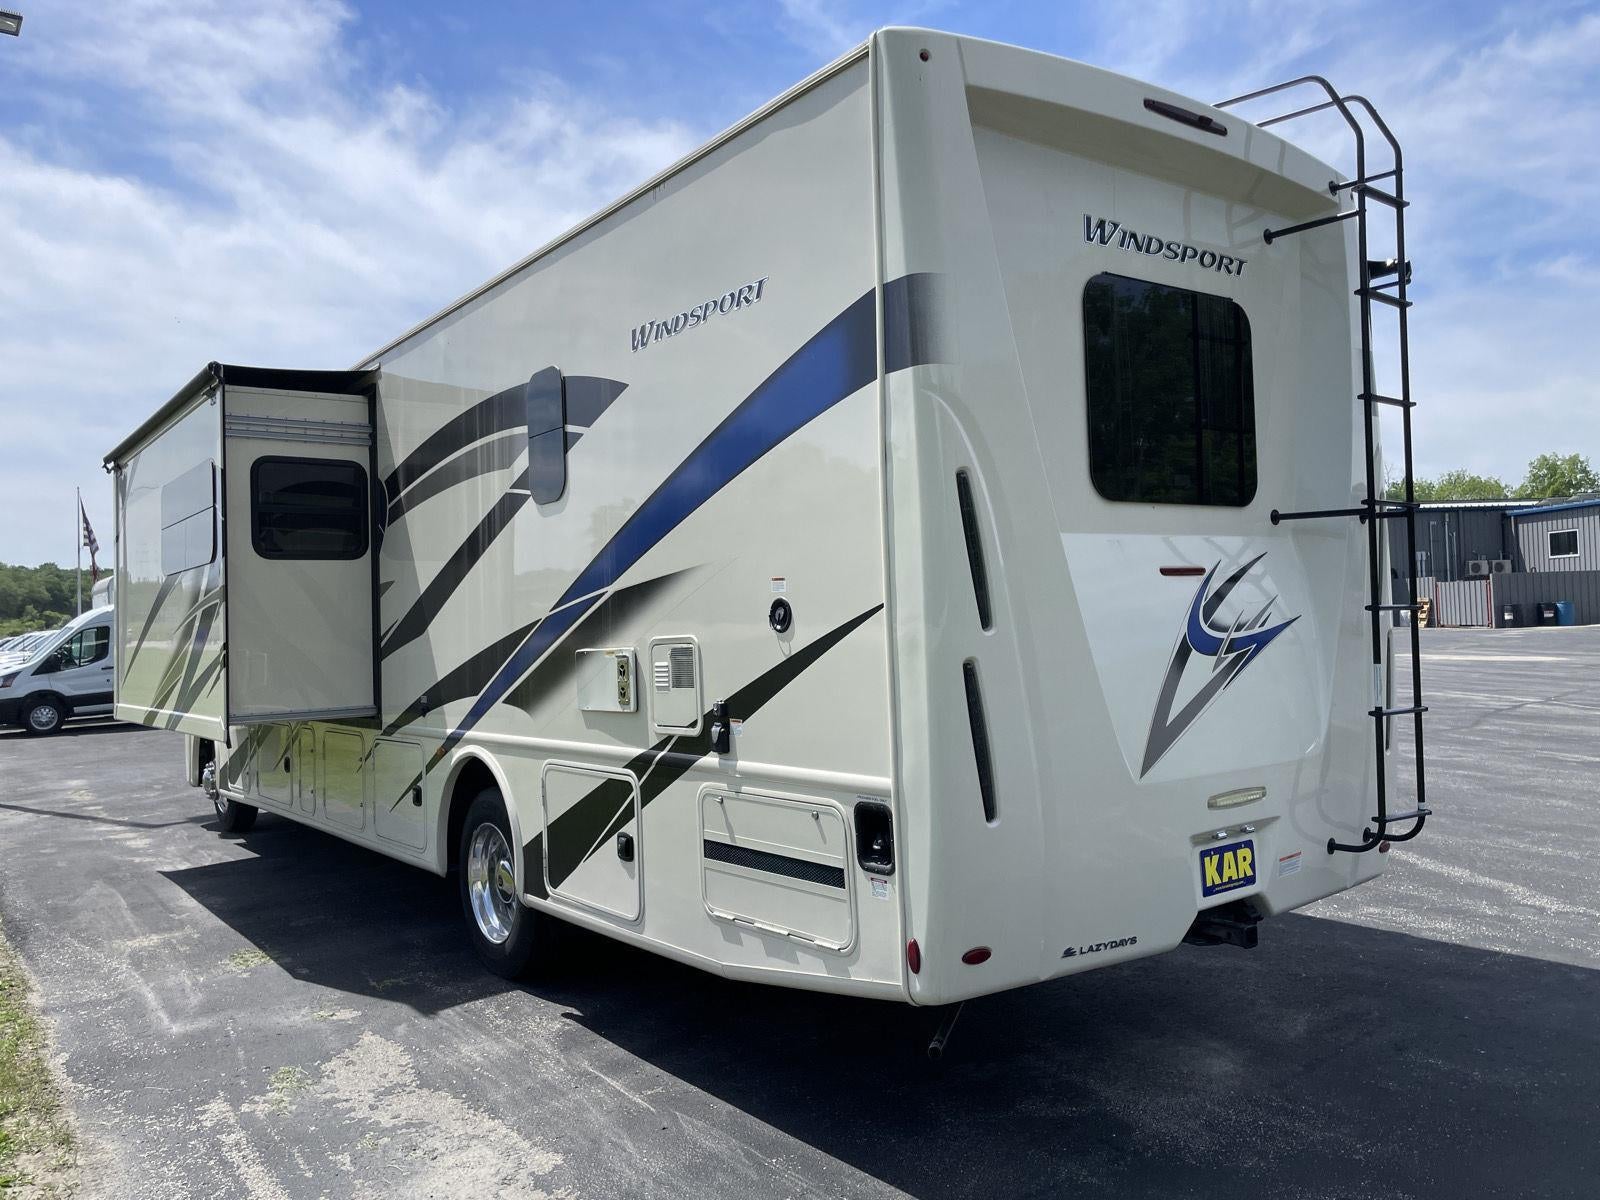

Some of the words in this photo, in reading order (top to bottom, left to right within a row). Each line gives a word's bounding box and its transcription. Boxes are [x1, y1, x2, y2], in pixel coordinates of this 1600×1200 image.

[1082, 212, 1248, 277] WINDSPORT
[630, 276, 769, 353] WINDSPORT
[1204, 847, 1254, 887] KAR
[1079, 936, 1138, 955] LAZYDAYS
